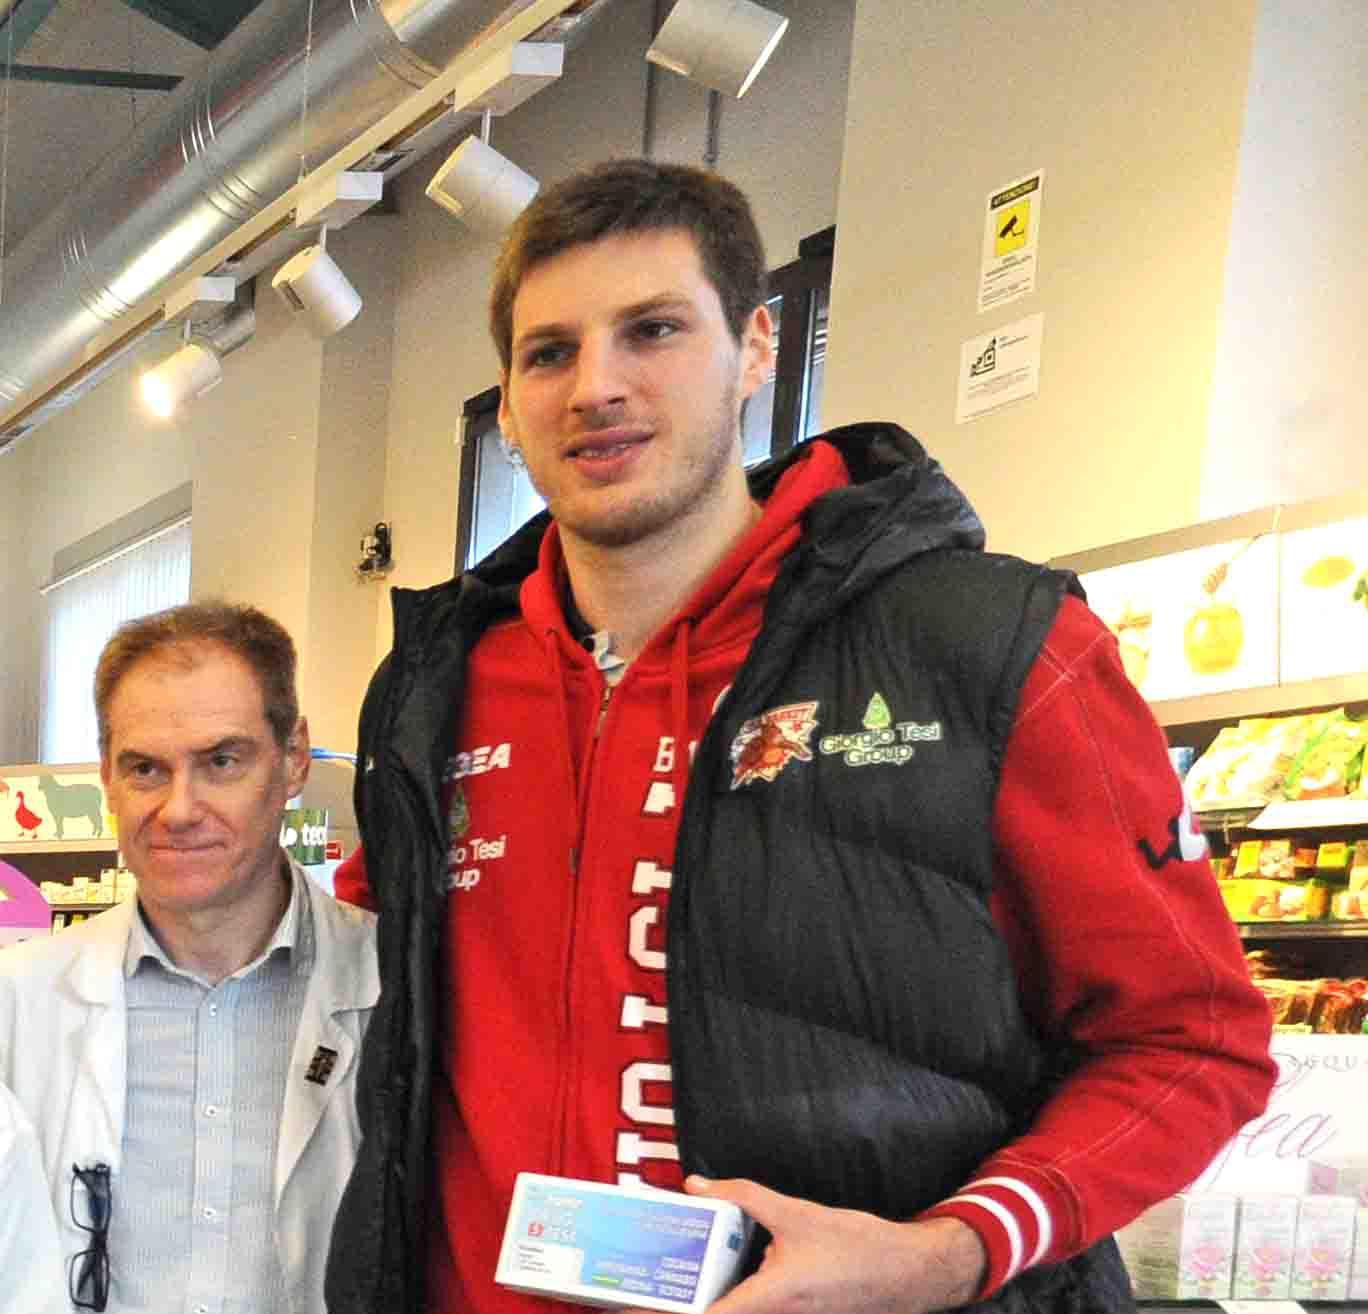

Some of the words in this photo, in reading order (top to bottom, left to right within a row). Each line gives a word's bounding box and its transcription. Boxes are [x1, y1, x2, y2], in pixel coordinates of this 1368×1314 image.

[819, 728, 895, 755] Giorgio
[896, 721, 943, 742] Tesi
[844, 744, 914, 768] Group
